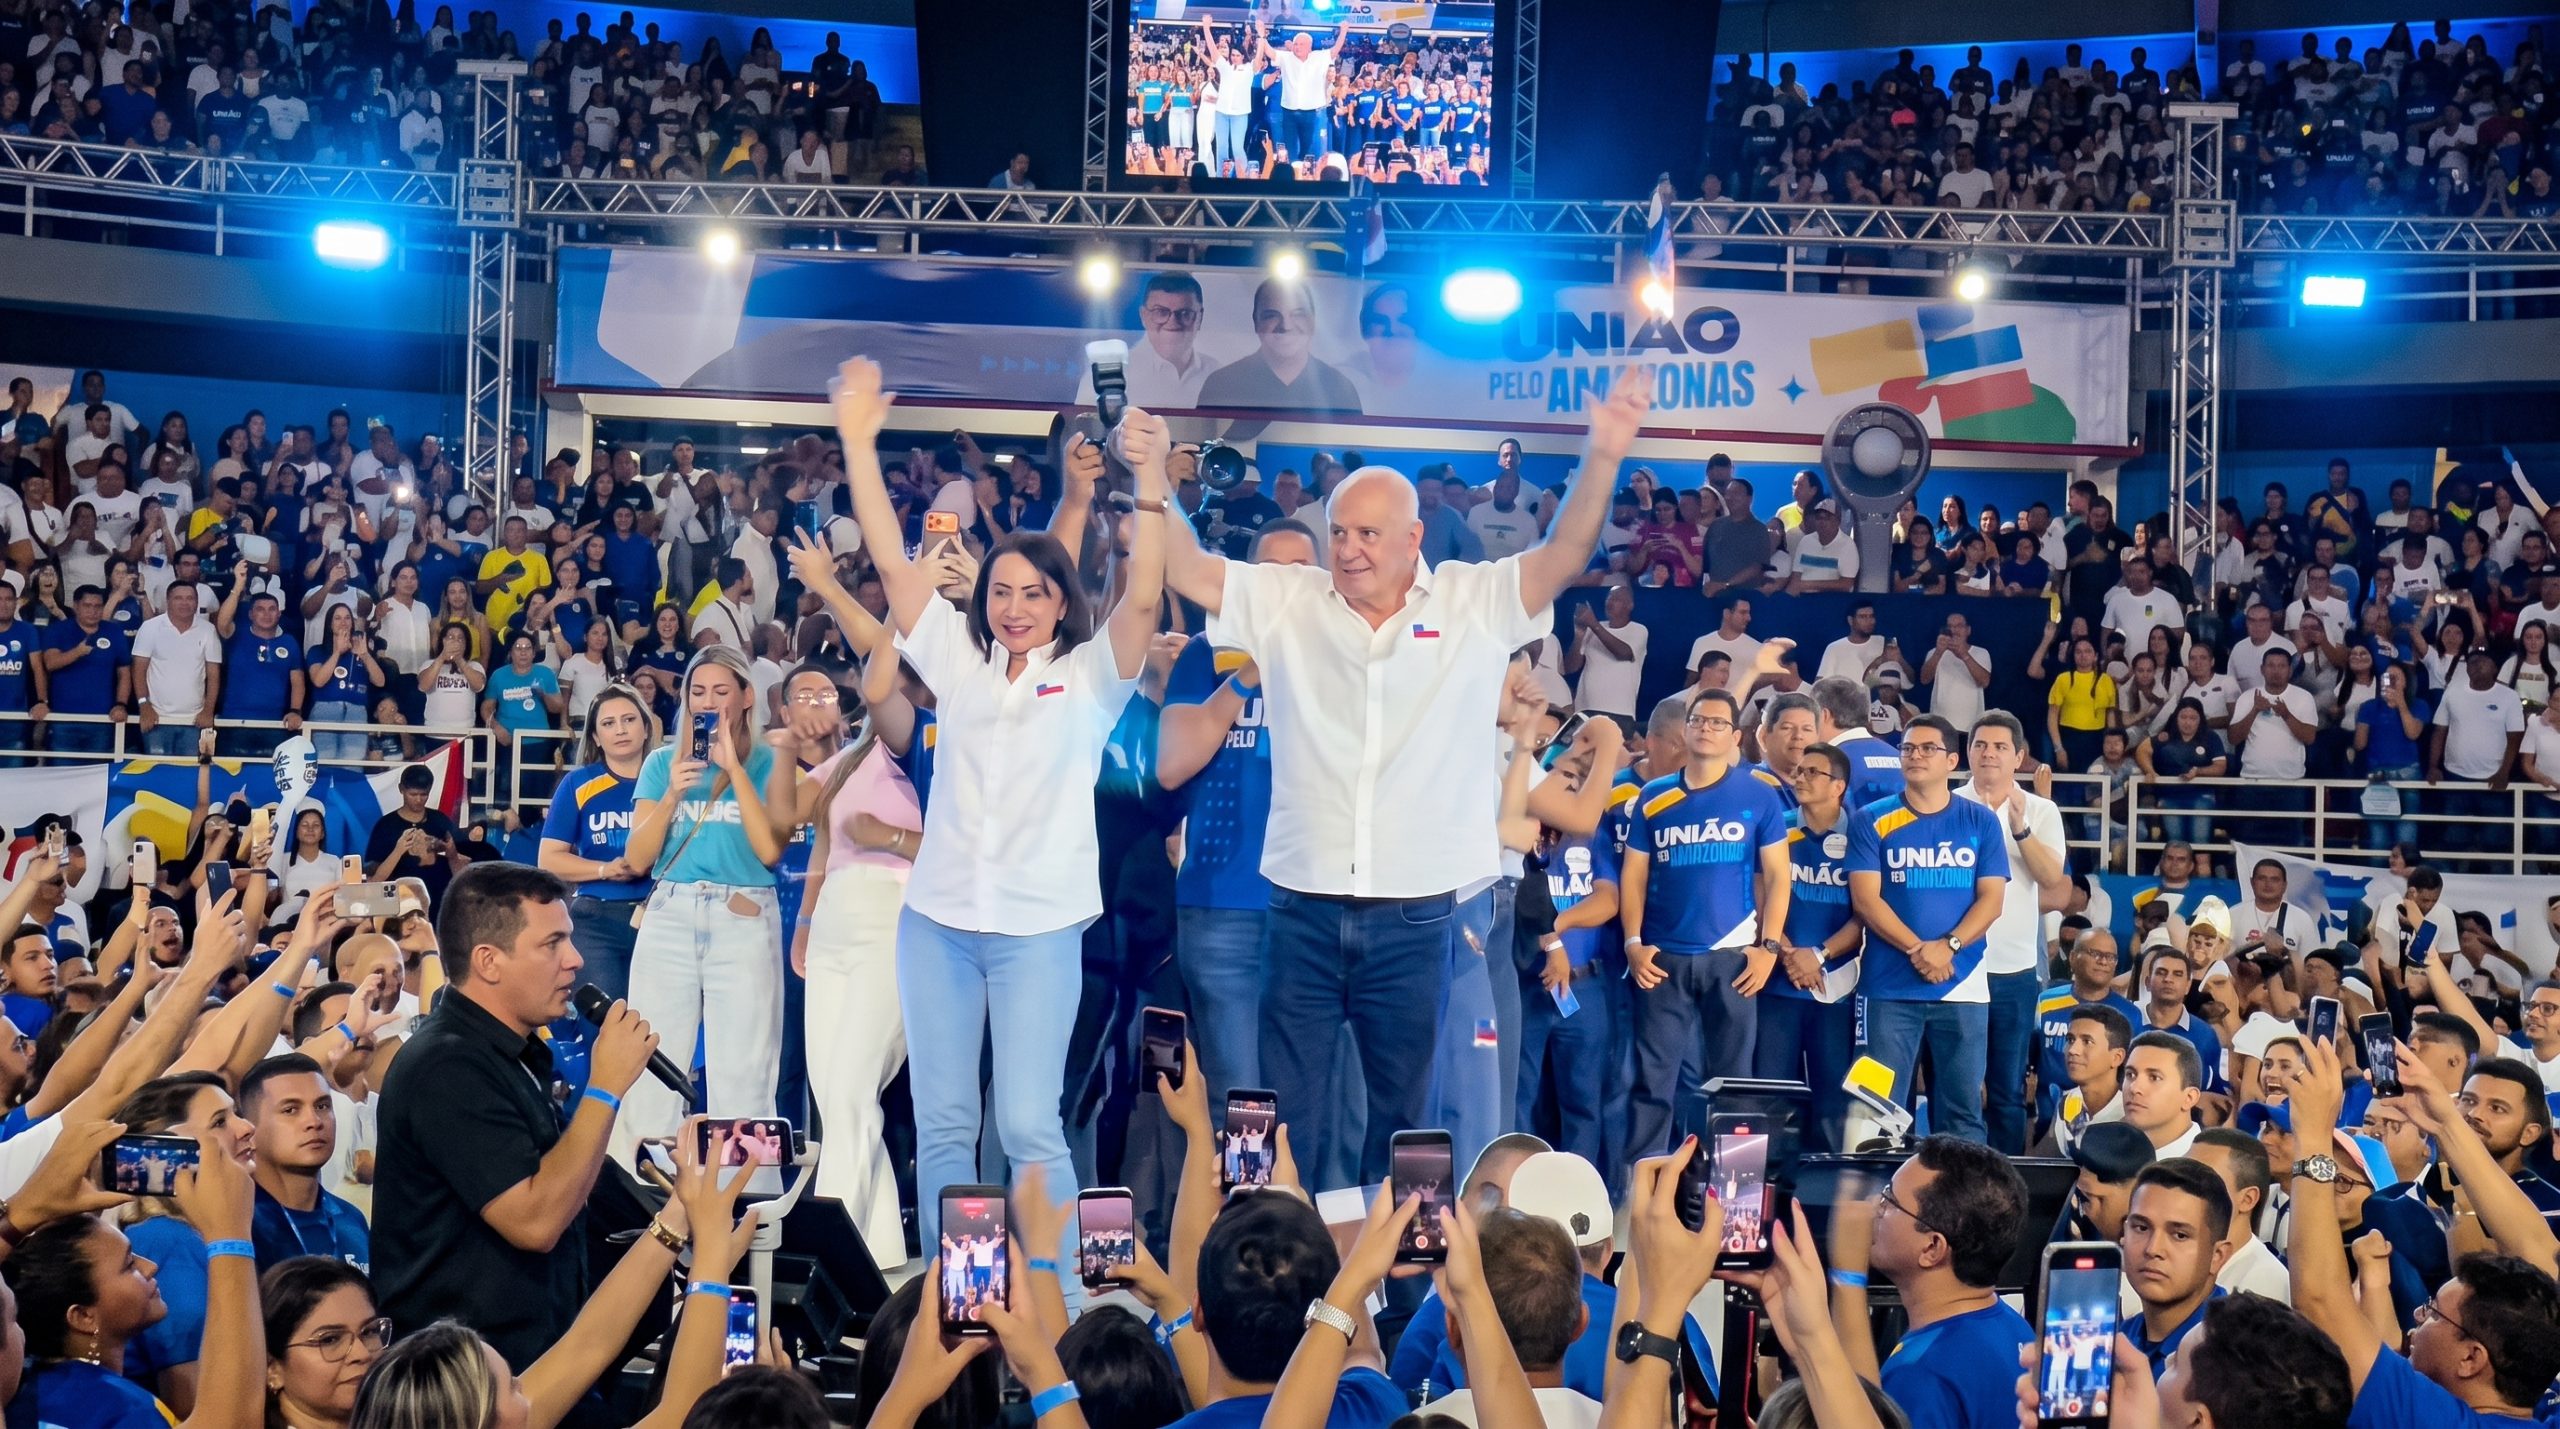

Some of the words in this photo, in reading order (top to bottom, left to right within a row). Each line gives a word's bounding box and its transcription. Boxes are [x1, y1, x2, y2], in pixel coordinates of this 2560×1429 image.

[1490, 371, 1543, 400] PELO
[1225, 730, 1256, 748] PELO
[1654, 818, 1745, 848] UNIÃO
[1887, 841, 1976, 869] UNIÃO
